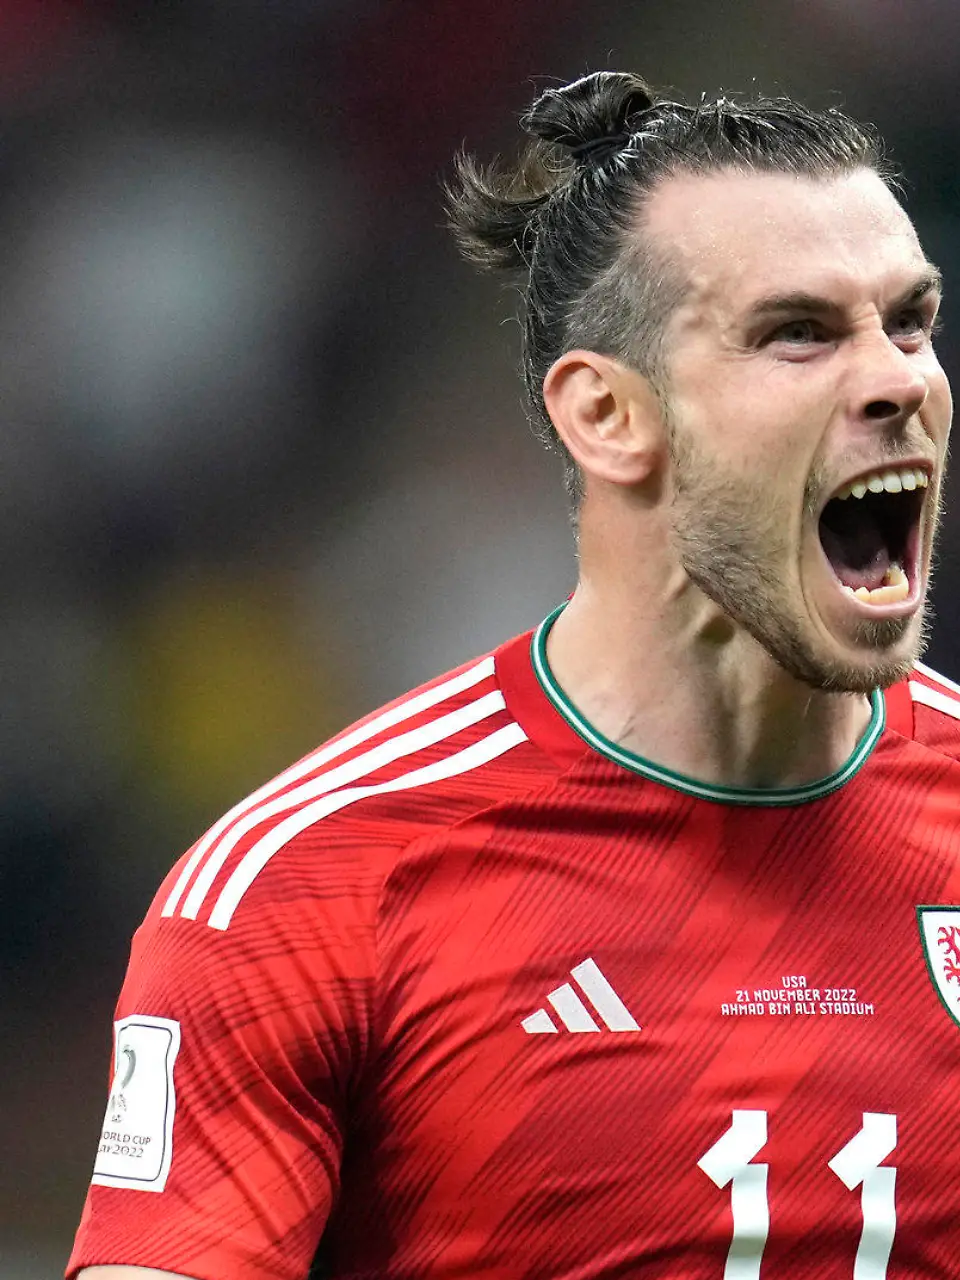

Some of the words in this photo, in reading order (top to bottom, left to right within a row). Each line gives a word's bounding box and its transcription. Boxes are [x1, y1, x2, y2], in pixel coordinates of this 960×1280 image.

[782, 976, 807, 988] USA
[736, 990, 749, 1002] 21
[754, 989, 821, 1002] NOVEMBER
[824, 989, 856, 1001] 2022
[721, 1003, 765, 1016] AHMAD
[769, 1003, 791, 1015] BIN
[795, 1003, 815, 1015] ALI
[819, 1003, 875, 1015] STADIUM
[102, 1131, 130, 1143] ORLD
[132, 1135, 151, 1146] CUP
[99, 1144, 144, 1158] ar2022
